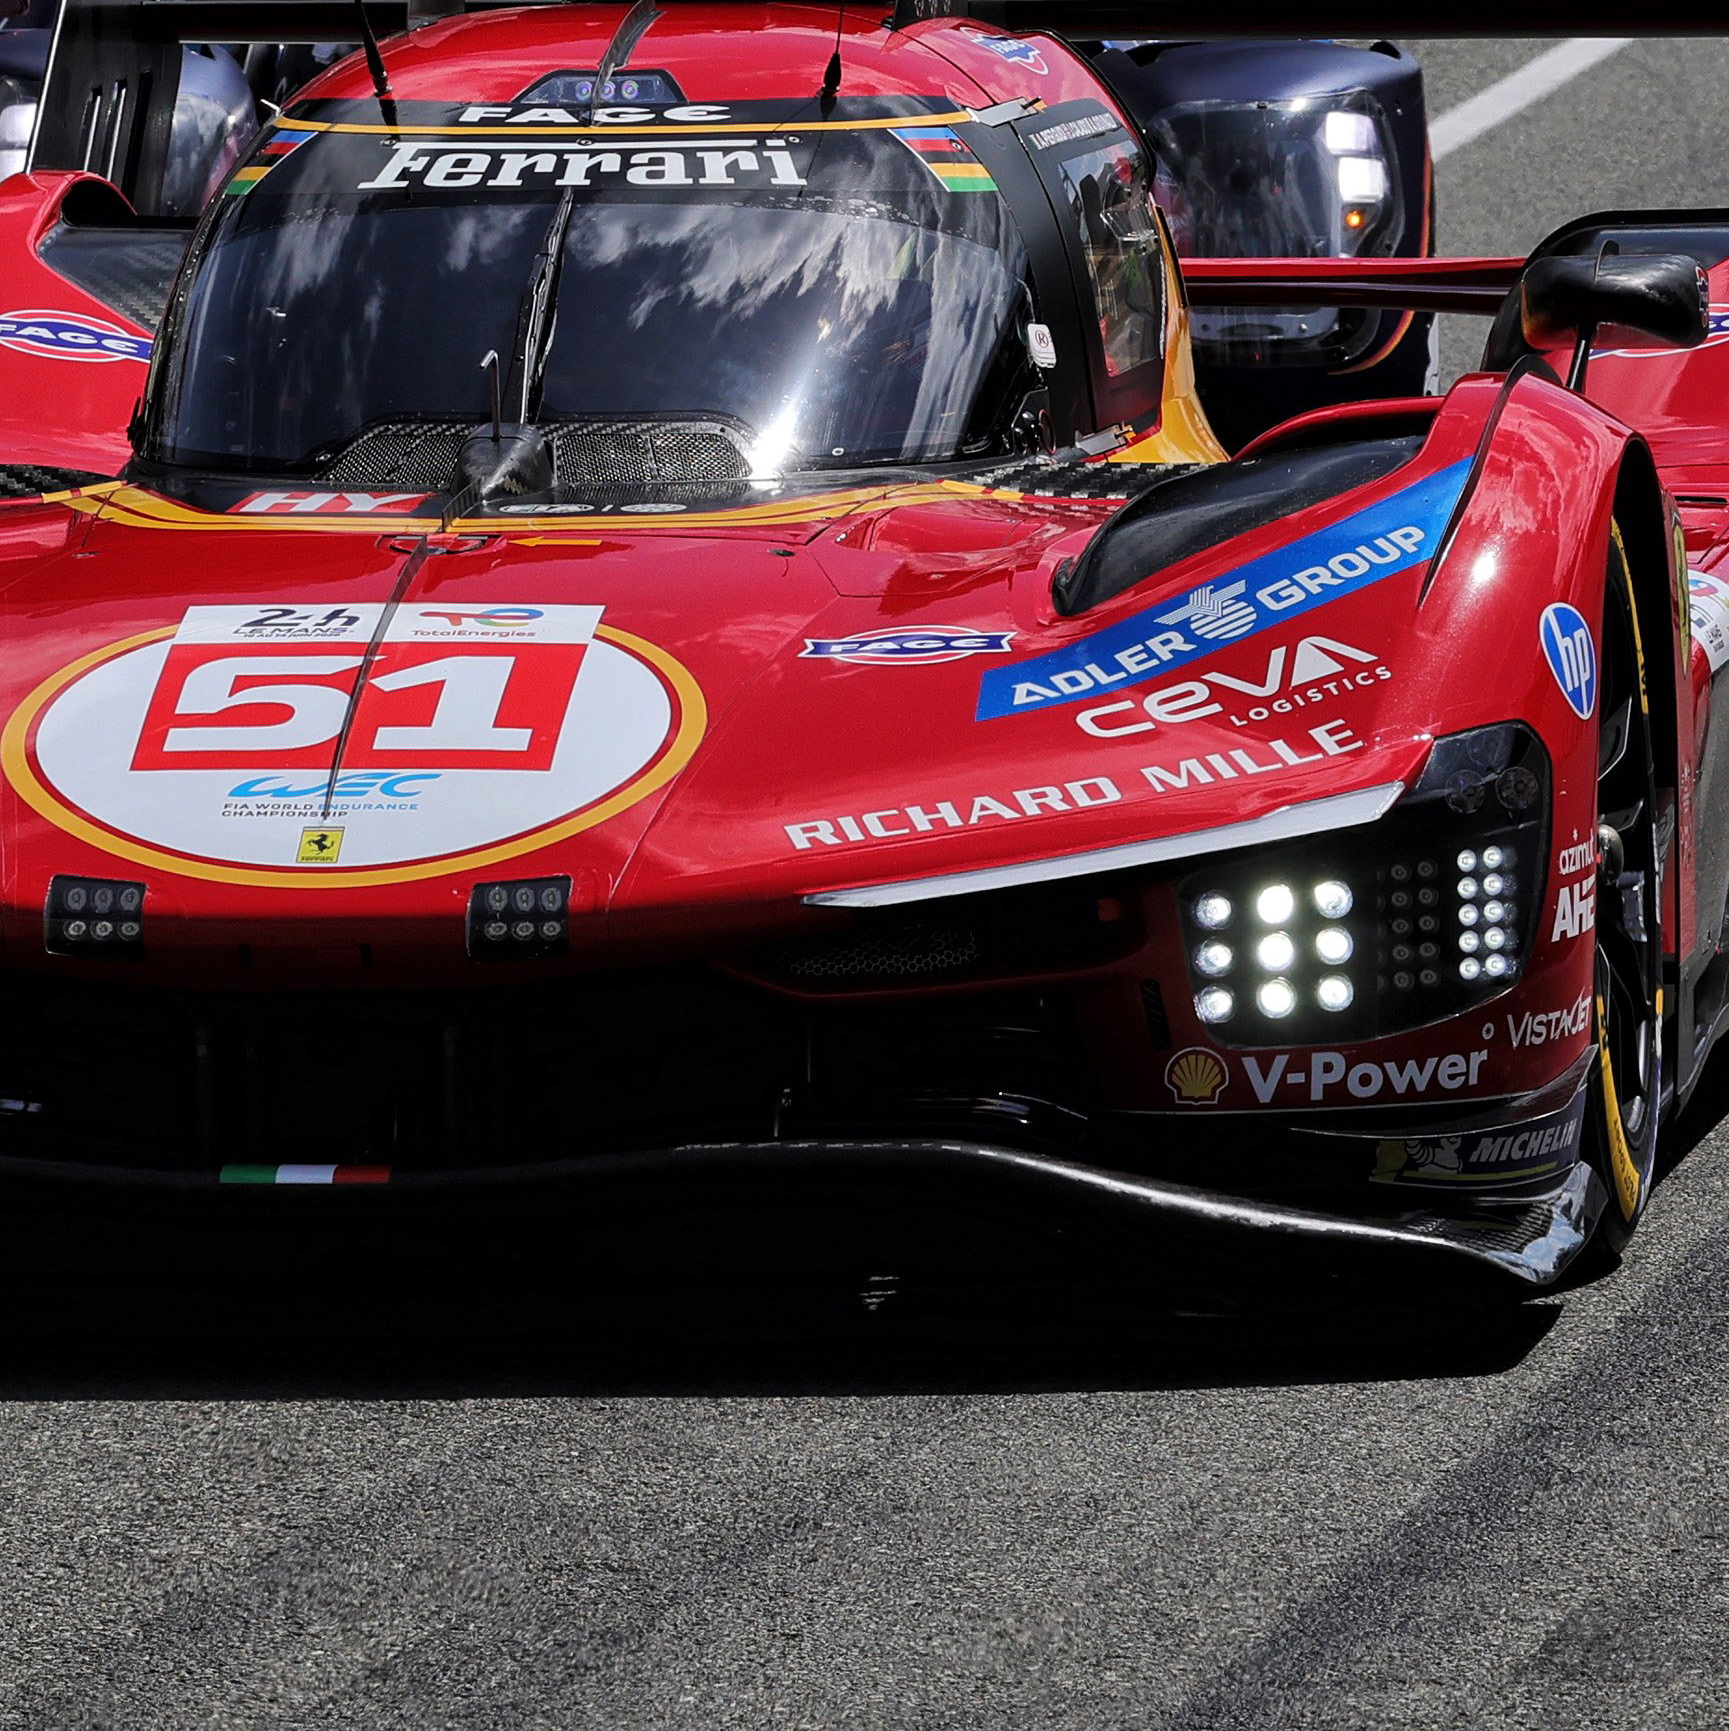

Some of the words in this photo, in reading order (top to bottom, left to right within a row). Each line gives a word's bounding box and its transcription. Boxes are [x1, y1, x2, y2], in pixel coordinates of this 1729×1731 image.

[459, 104, 731, 126] FAGE
[357, 137, 808, 190] Ferrari
[248, 491, 410, 513] HY
[410, 628, 537, 640] TotalEnergies
[1010, 629, 1202, 707] ADLER
[1254, 523, 1427, 613] GROUP
[832, 635, 987, 656] FAGE
[1559, 613, 1594, 707] hp
[162, 654, 534, 753] 51
[1228, 664, 1393, 728] LOGISTICS
[222, 802, 253, 811] FIA
[254, 803, 314, 811] WORLD
[316, 802, 420, 811] ENDURANCE
[226, 772, 446, 799] WEC
[784, 773, 1124, 852] RICHARD
[1139, 717, 1368, 794] MILLE
[221, 810, 348, 819] CHAMPIONSHIP
[1507, 990, 1592, 1049] VISTAJET
[1243, 1048, 1490, 1104] V-Power
[1469, 1118, 1578, 1163] MICHELIN
